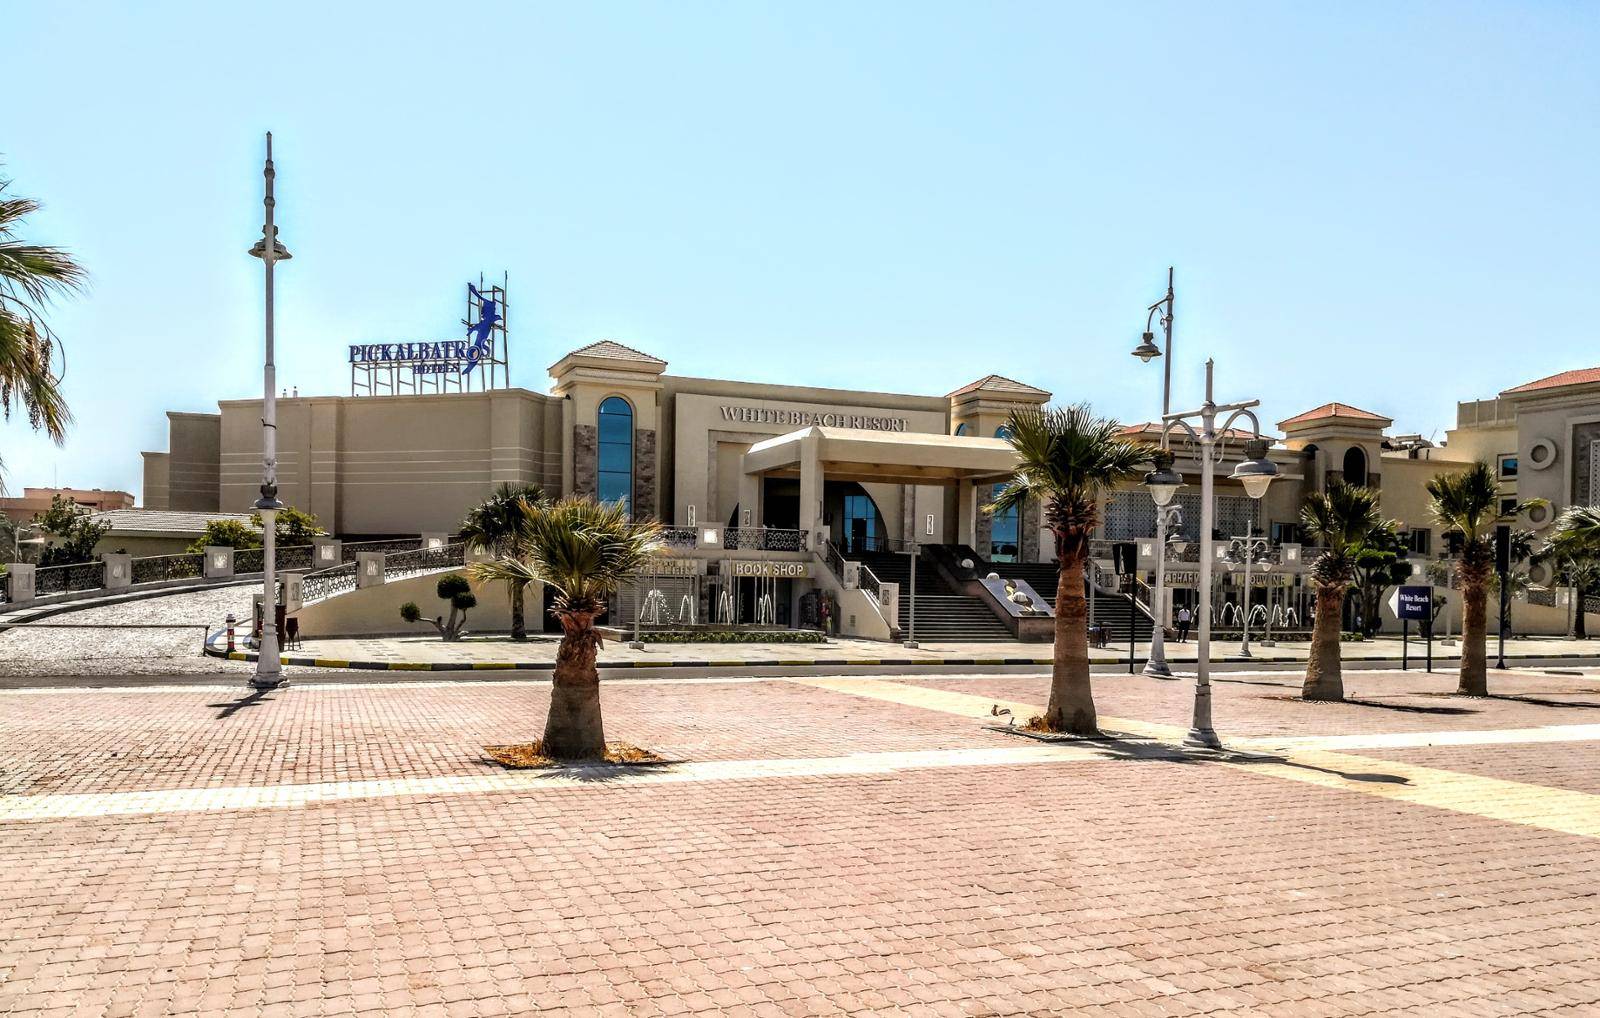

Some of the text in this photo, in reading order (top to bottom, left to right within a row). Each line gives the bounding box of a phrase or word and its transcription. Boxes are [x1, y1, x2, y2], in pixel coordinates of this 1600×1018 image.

[348, 339, 492, 363] PICKALBATROS
[413, 363, 460, 375] HOTELS
[720, 406, 910, 432] WHITE BEACH RESORT
[736, 563, 804, 576] BOOK SHOP
[1400, 594, 1429, 603] White Beach
[1405, 603, 1422, 611] Resort
